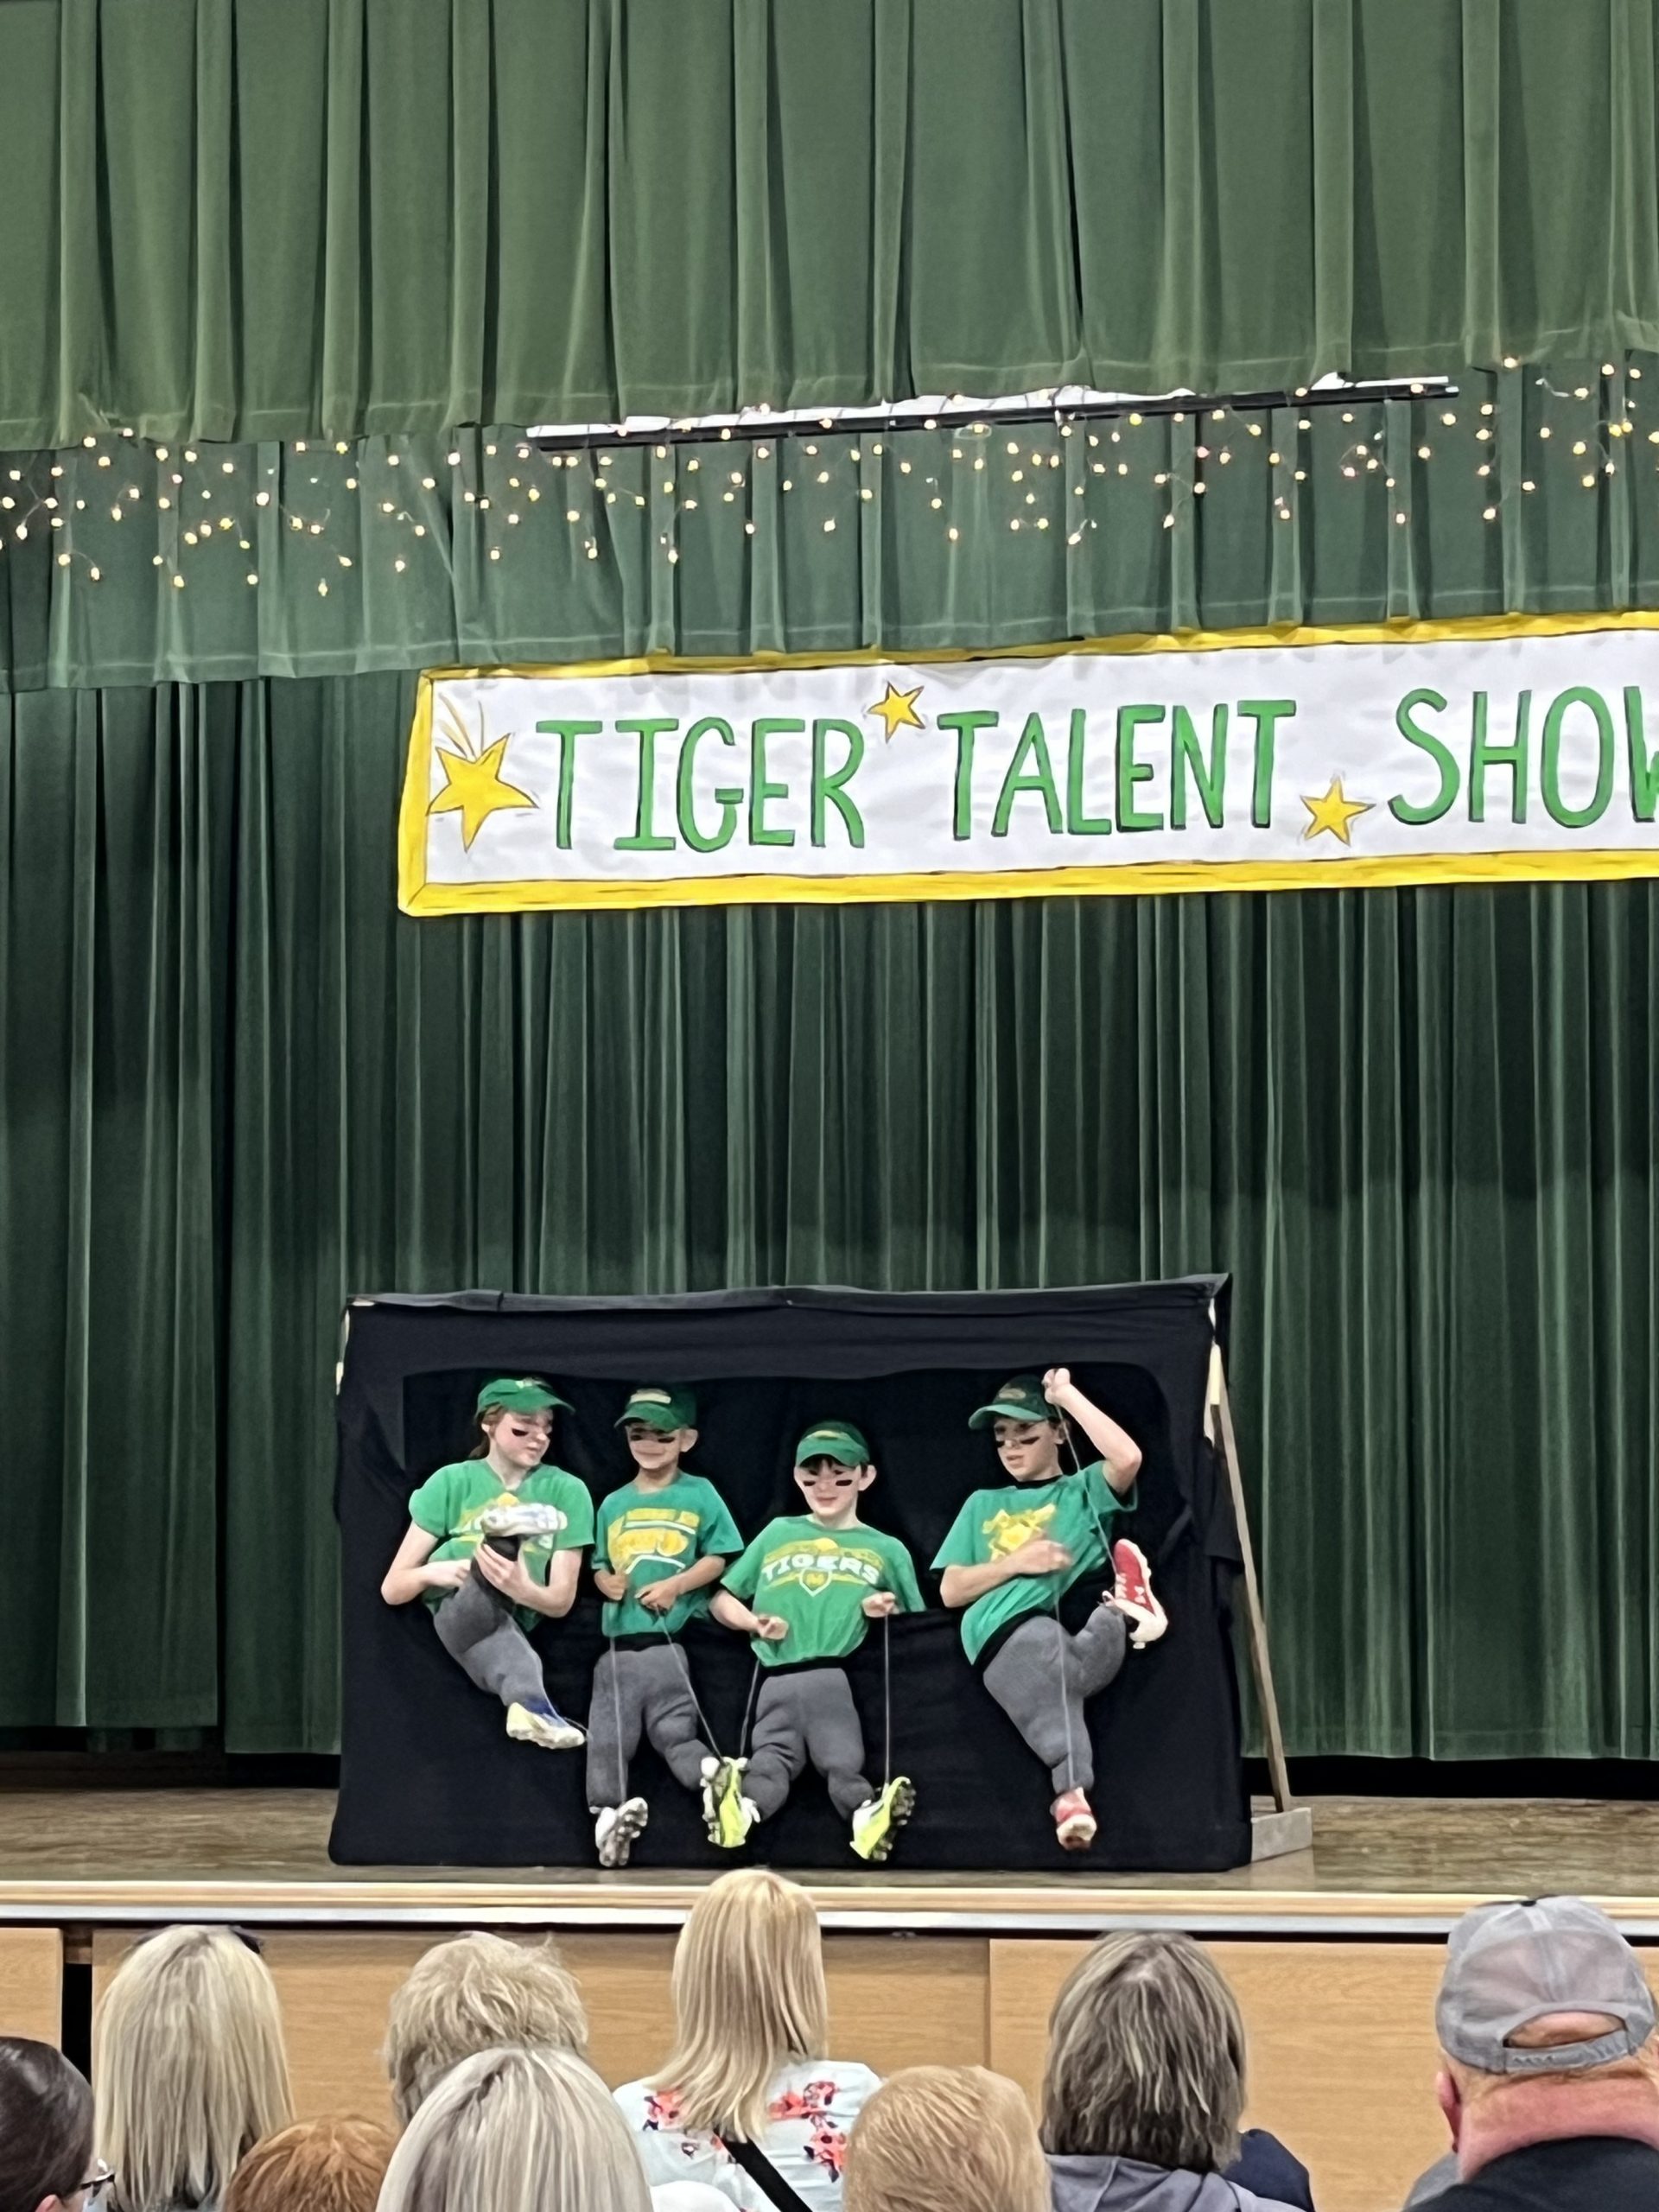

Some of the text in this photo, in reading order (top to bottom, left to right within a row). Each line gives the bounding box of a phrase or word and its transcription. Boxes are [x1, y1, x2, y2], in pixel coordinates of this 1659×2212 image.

[536, 716, 865, 853] TIGER
[938, 699, 1295, 840] TALENT
[761, 1553, 880, 1586] TIGERS
